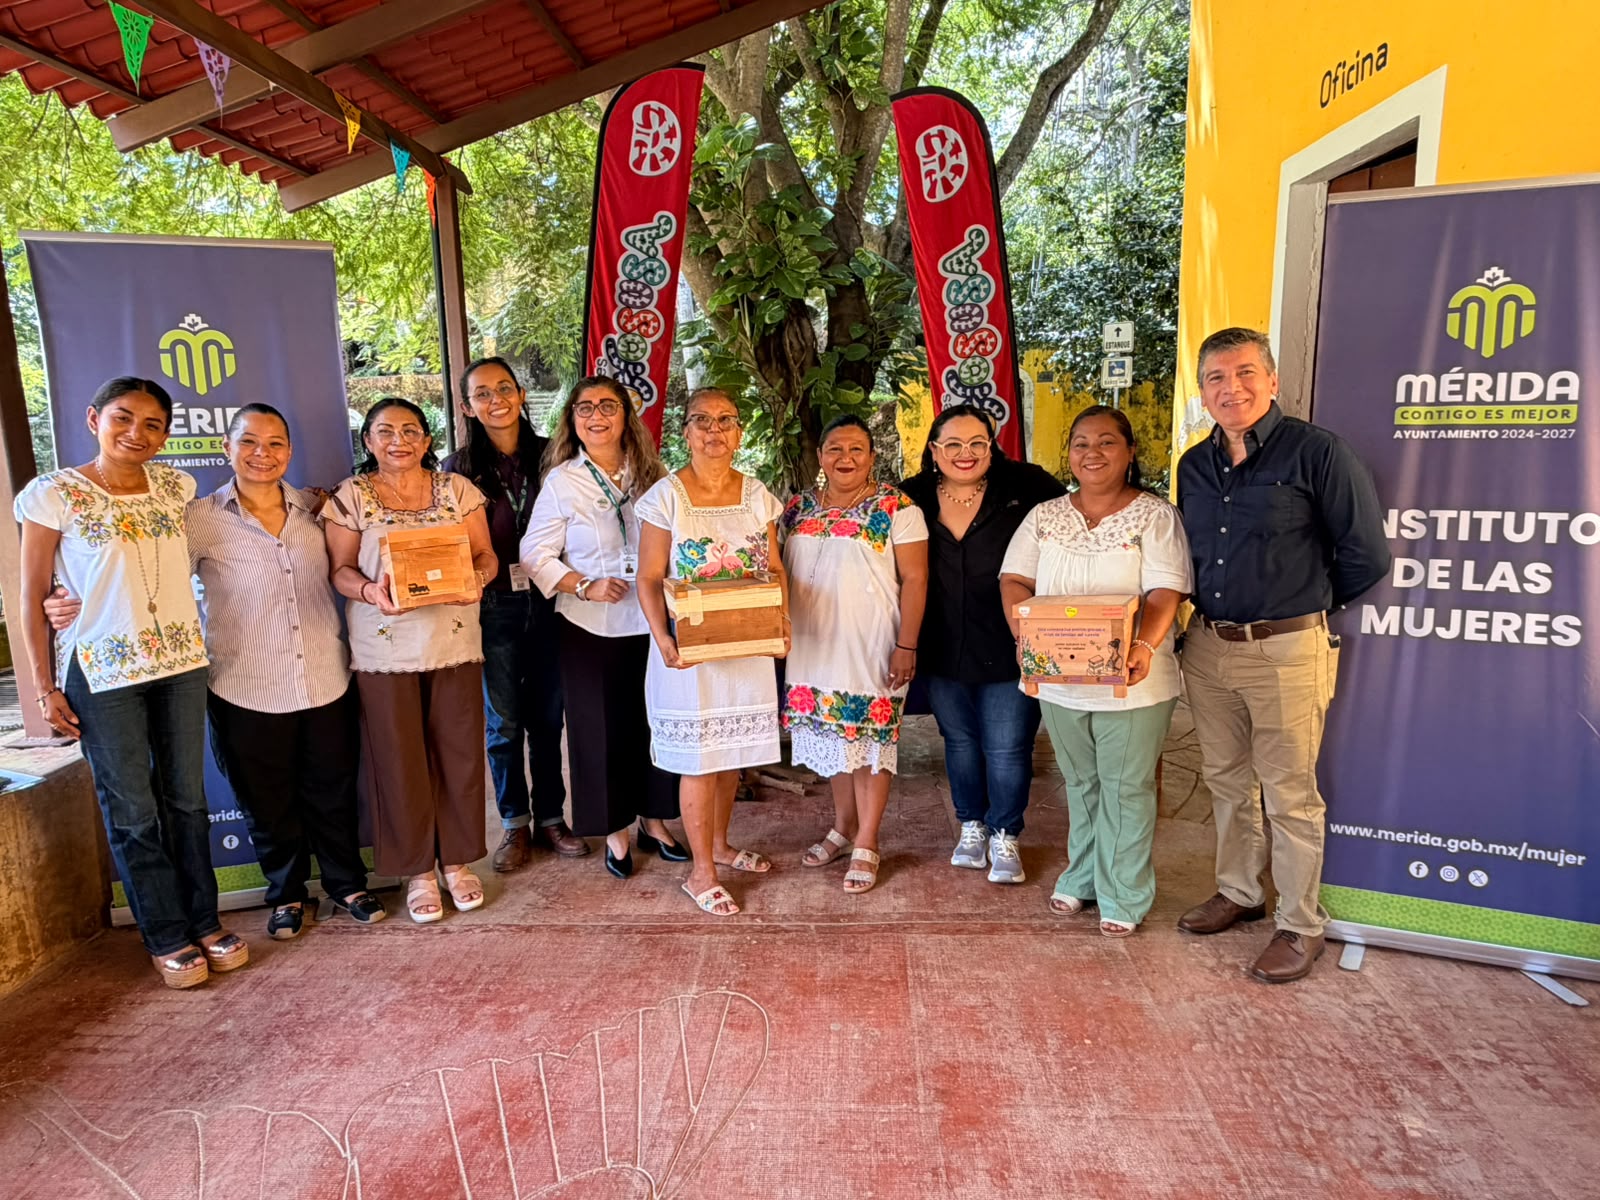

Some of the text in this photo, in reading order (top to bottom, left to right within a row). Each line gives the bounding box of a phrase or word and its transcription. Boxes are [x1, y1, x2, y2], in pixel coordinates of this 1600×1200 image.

[1319, 41, 1389, 109] Oficina
[1395, 366, 1580, 403] MÉRIDA
[171, 402, 242, 435] ÉRI
[1400, 408, 1571, 421] CONTIGO ES MEJOR
[164, 440, 203, 451] TIGO
[1393, 428, 1576, 440] AYUNTAMIENTO 2024-2027
[151, 458, 225, 468] TAMIENTO
[1382, 508, 1600, 546] NSTITUTO
[1392, 557, 1553, 595] DE LAS
[1360, 604, 1583, 647] MUJERES
[1329, 822, 1587, 867] www.merida.gob.mx/mujer
